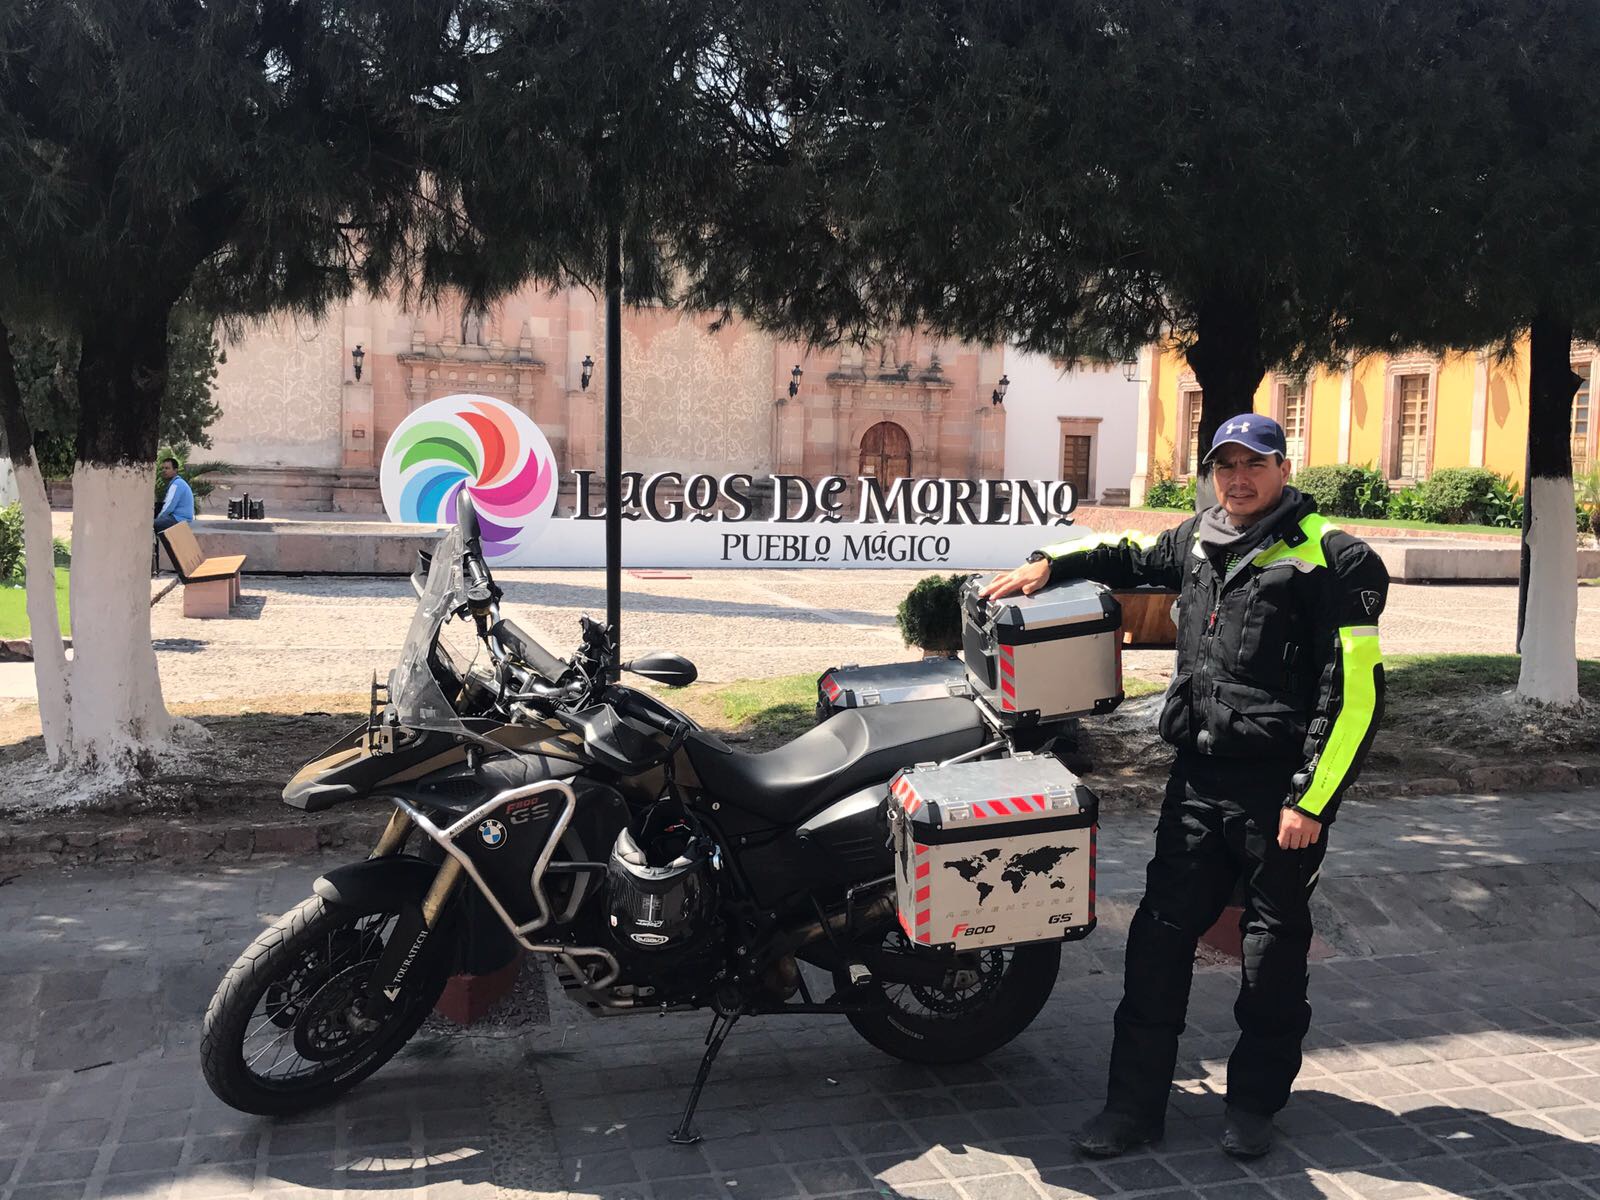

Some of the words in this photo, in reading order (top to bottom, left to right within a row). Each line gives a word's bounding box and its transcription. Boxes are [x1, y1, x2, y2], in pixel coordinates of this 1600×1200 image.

[769, 474, 846, 524] De
[858, 476, 1078, 527] MoRENo
[721, 534, 832, 563] PUEBLo
[510, 802, 549, 825] GS
[952, 923, 996, 938] F800
[1048, 913, 1073, 925] GS
[393, 930, 429, 983] TOURATECH
